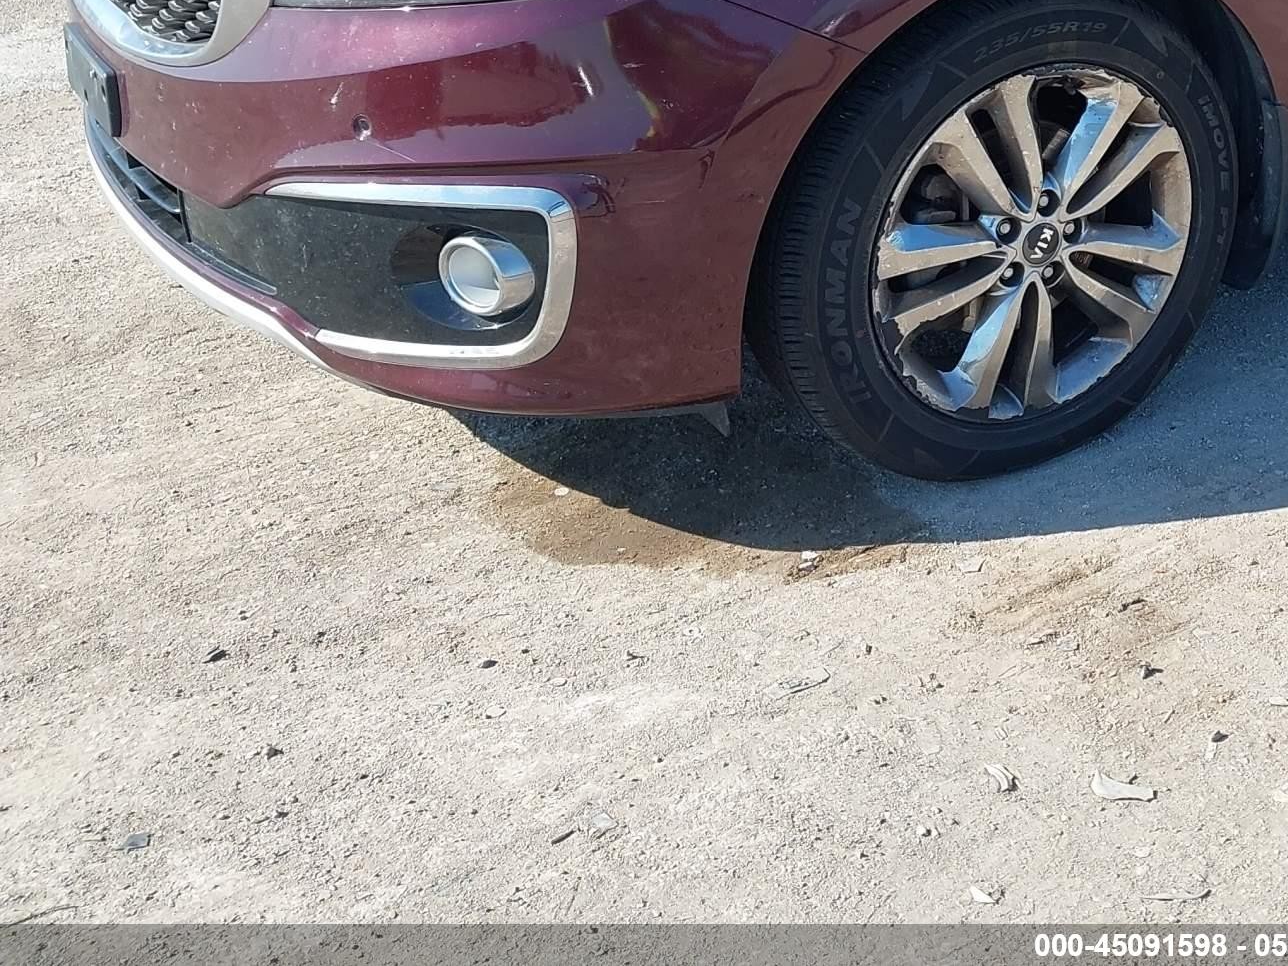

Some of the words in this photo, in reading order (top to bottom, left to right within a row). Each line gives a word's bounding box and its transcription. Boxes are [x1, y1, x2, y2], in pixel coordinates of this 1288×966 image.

[974, 21, 1107, 62] 235/55R19
[1029, 227, 1055, 259] KIA
[823, 197, 873, 404] IRONMAN
